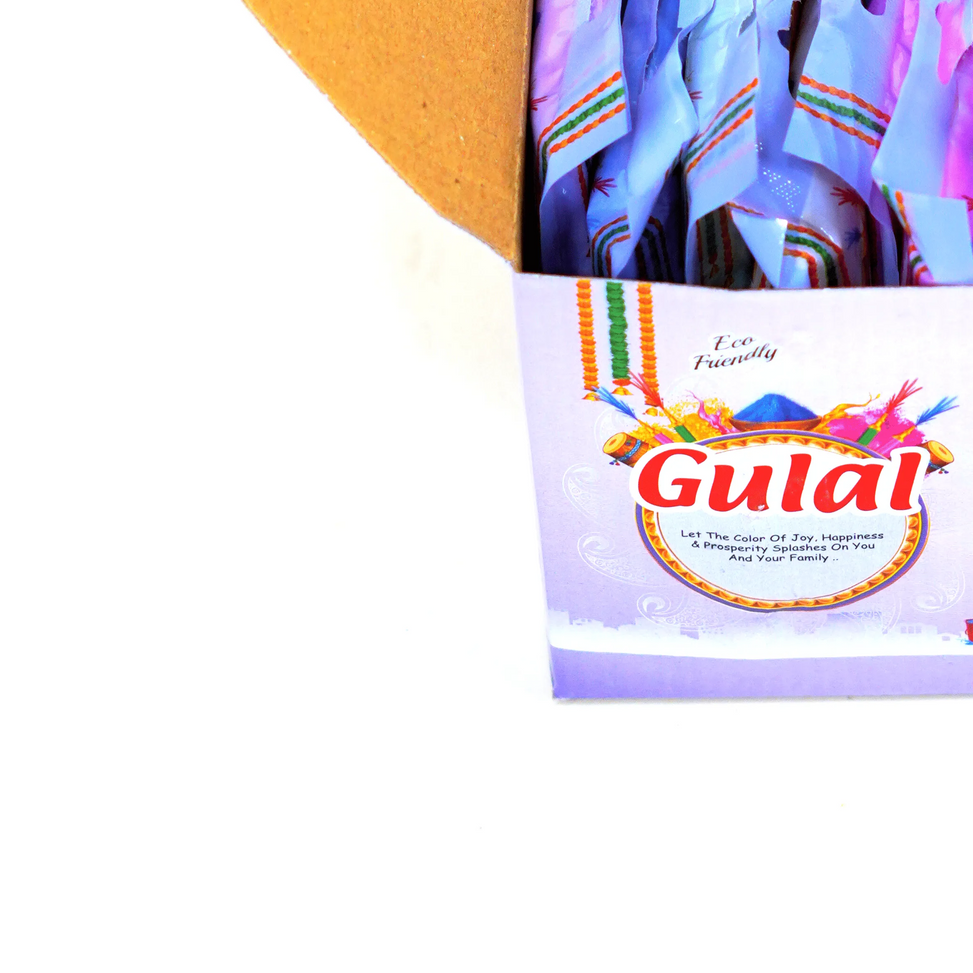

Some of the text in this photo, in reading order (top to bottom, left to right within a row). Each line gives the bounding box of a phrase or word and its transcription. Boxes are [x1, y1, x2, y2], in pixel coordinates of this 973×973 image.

[713, 334, 756, 351] Eco
[693, 343, 778, 370] Friendly
[638, 448, 922, 514] Gulal
[681, 530, 702, 539] Let
[706, 531, 730, 541] The
[733, 534, 766, 543] Color
[770, 534, 787, 543] Of
[822, 532, 884, 544] Happiness
[691, 540, 875, 554] & Prosperity Splashes On You
[729, 553, 752, 562] And
[756, 554, 786, 562] Your
[789, 553, 829, 563] Family
